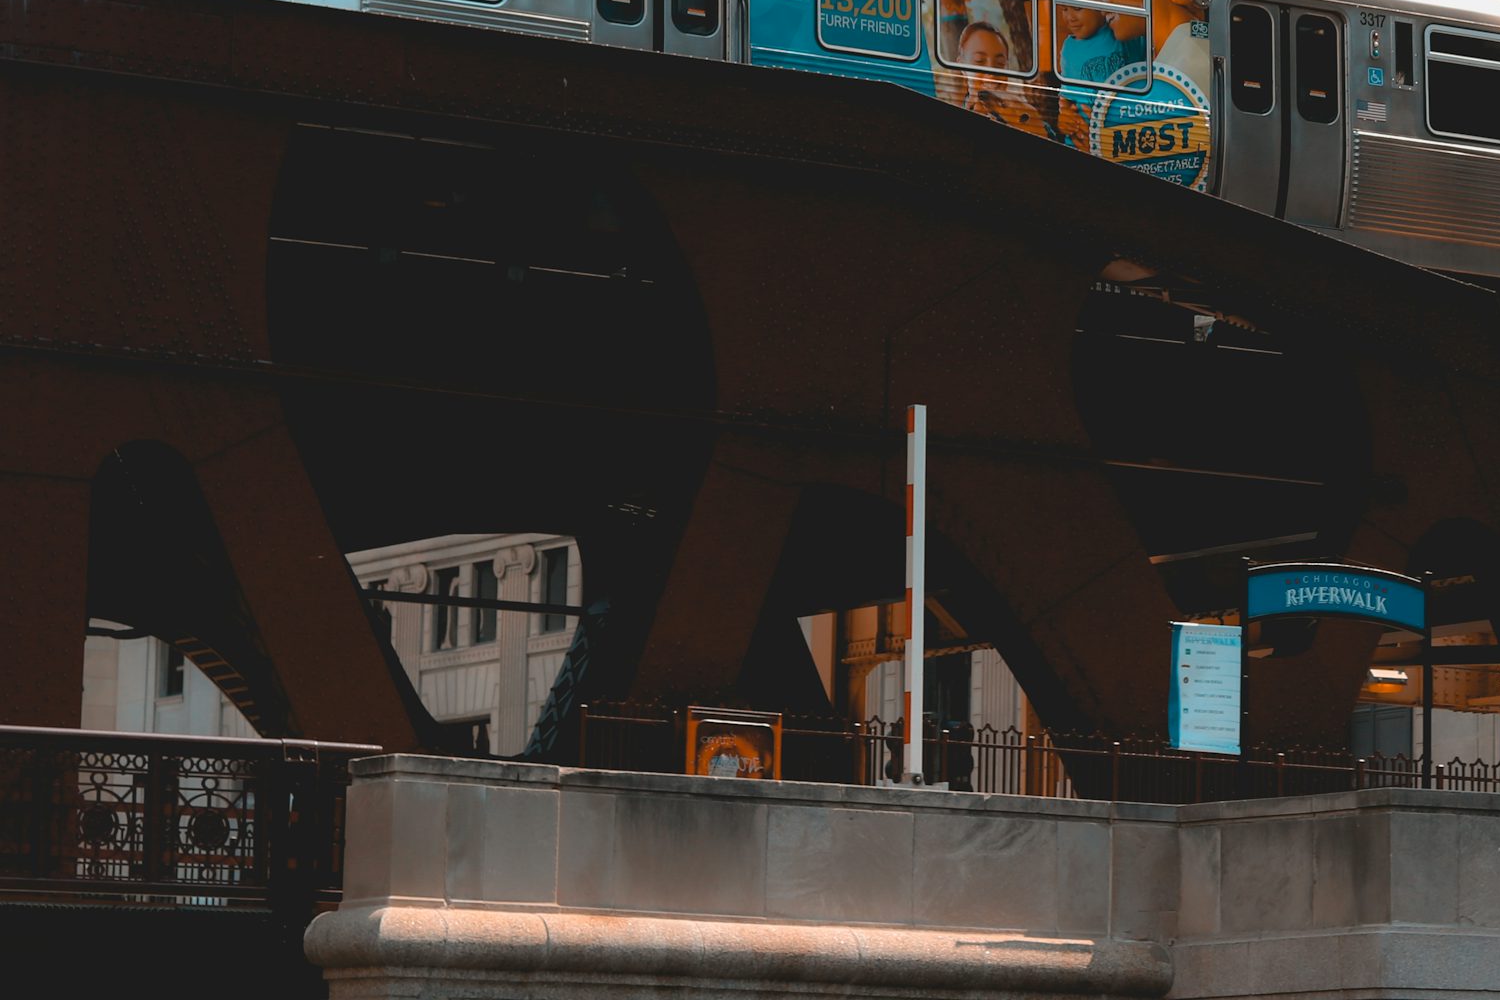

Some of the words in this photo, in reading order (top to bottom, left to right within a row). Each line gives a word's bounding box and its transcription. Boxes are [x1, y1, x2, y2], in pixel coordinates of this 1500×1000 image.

[819, 12, 858, 31] FURRY
[860, 19, 911, 38] FRIENDS
[1359, 11, 1386, 28] 3317
[1119, 98, 1184, 119] FLORIDA'S
[1112, 121, 1194, 158] MOST
[1131, 156, 1200, 175] ORGETTABLE
[1302, 574, 1370, 589] CHICAGO
[1284, 586, 1388, 615] RIVERWALK
